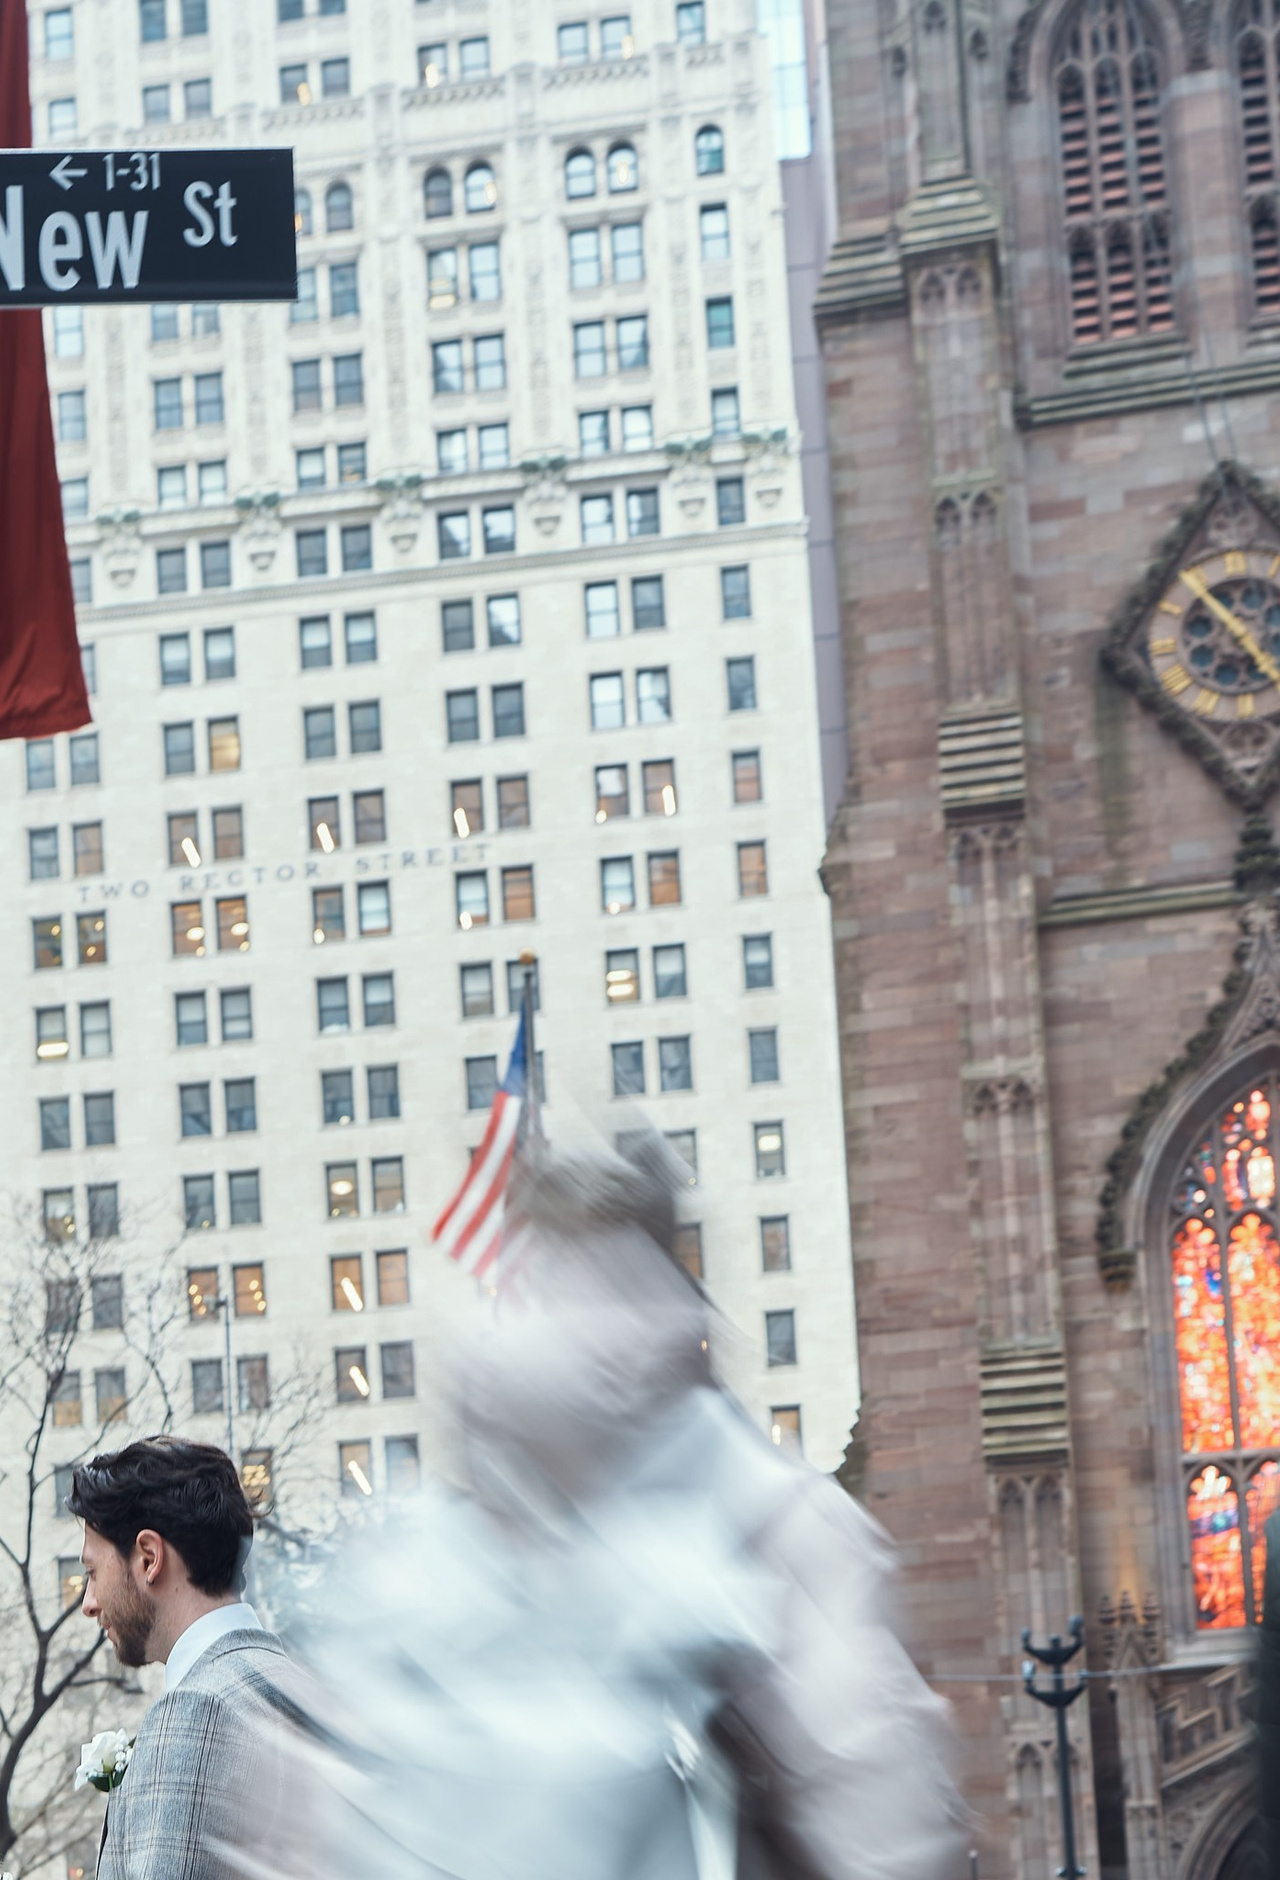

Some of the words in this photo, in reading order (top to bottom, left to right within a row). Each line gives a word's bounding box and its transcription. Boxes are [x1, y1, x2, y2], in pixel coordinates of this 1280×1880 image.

[102, 152, 161, 191] 1-31
[183, 180, 238, 247] St
[77, 880, 150, 902] TWO
[179, 861, 322, 892] RECTOR
[355, 843, 491, 871] STREET
